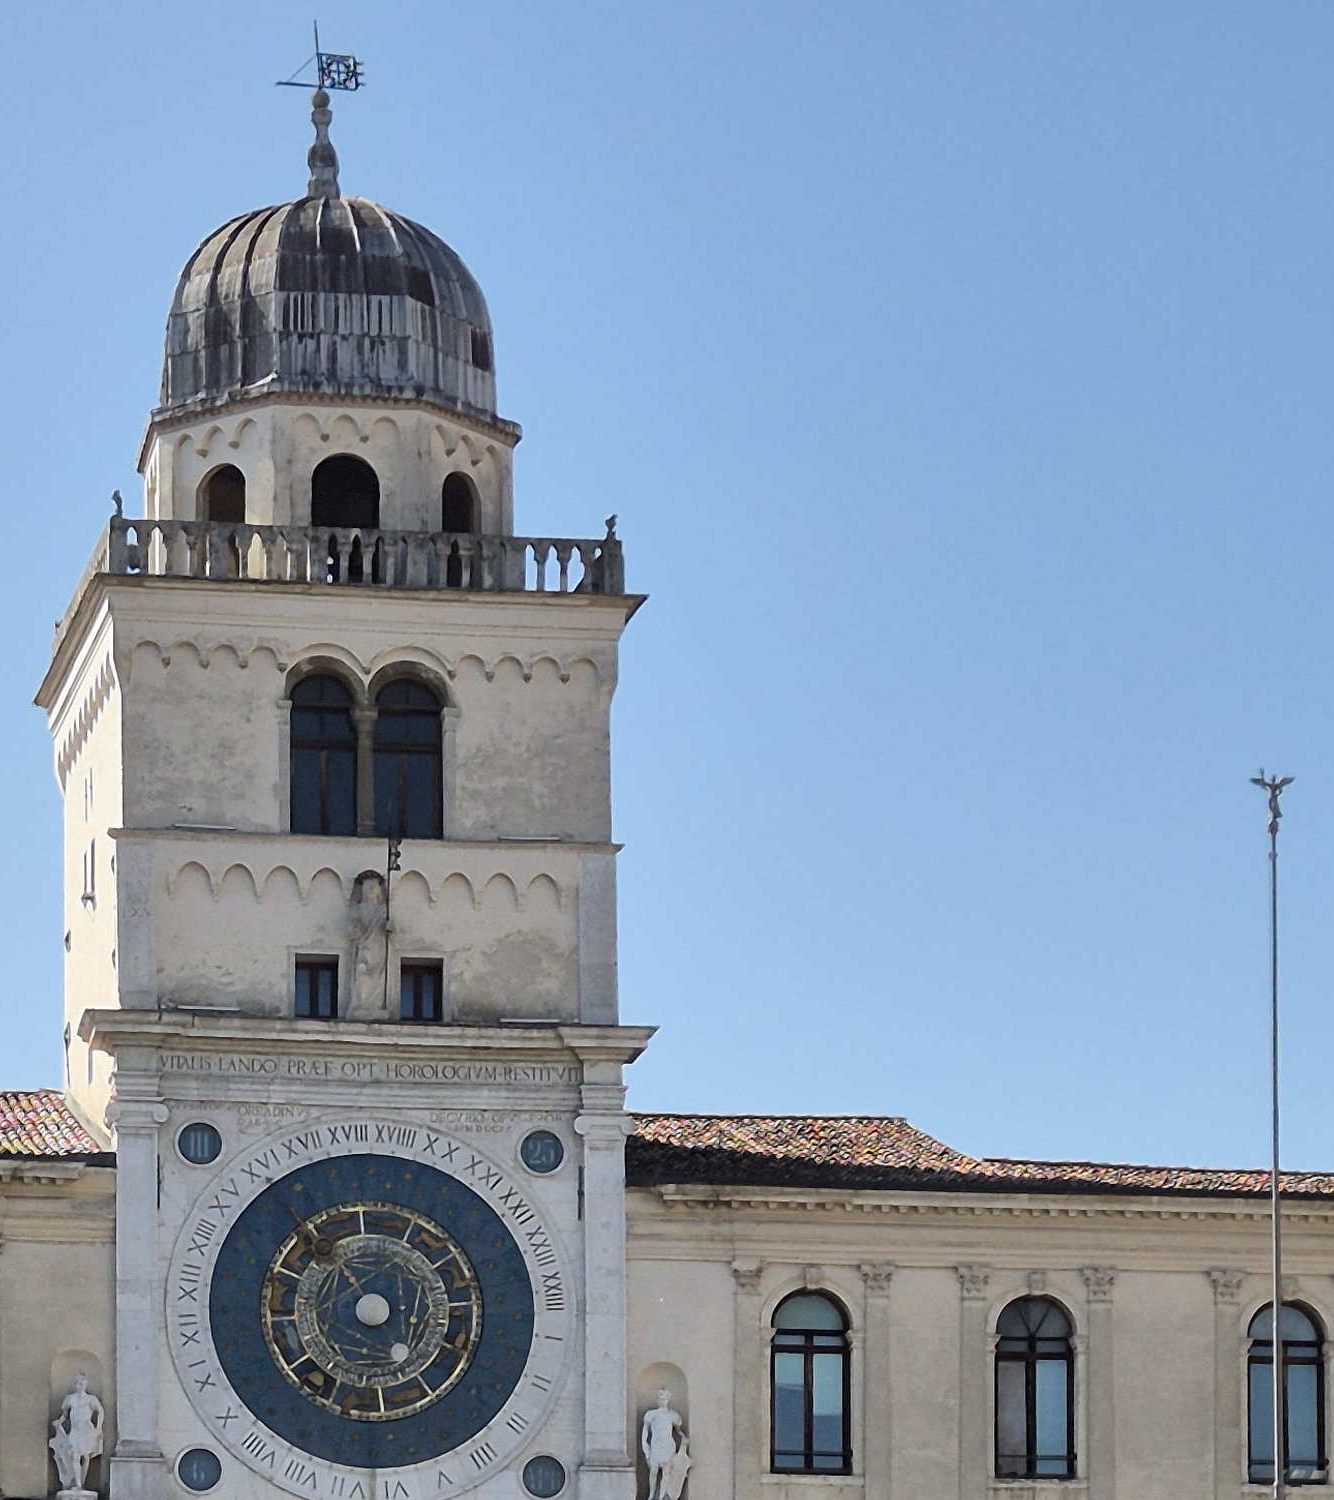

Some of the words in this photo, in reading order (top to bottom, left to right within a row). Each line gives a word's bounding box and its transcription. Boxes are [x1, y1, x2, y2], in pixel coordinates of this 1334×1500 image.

[219, 1057, 277, 1073] LANDO
[341, 1062, 377, 1078] OPT
[386, 1064, 497, 1081] HOROLOGIVM
[504, 1066, 579, 1082] RESTITVIT
[281, 1130, 323, 1160] XVII
[328, 1124, 368, 1145] XVIII
[375, 1124, 417, 1148] XVIIII
[422, 1133, 462, 1163] XX
[240, 1148, 281, 1184] XVI
[464, 1154, 503, 1190] XXI
[208, 1178, 240, 1218] XV
[498, 1186, 535, 1225] XXII
[187, 1218, 218, 1257] XIIII
[525, 1225, 557, 1267] XXIII
[178, 1263, 202, 1302] XIII
[541, 1271, 565, 1311] XXIIII
[178, 1313, 201, 1347] XII
[188, 1360, 217, 1393] XI
[531, 1374, 552, 1392] II
[215, 1406, 239, 1429] X
[505, 1412, 529, 1435] III
[241, 1432, 276, 1469] VIIII
[469, 1442, 498, 1470] IIII
[284, 1459, 317, 1490] VIII
[331, 1475, 367, 1500] VII
[438, 1470, 453, 1489] V
[384, 1480, 410, 1500] VI
